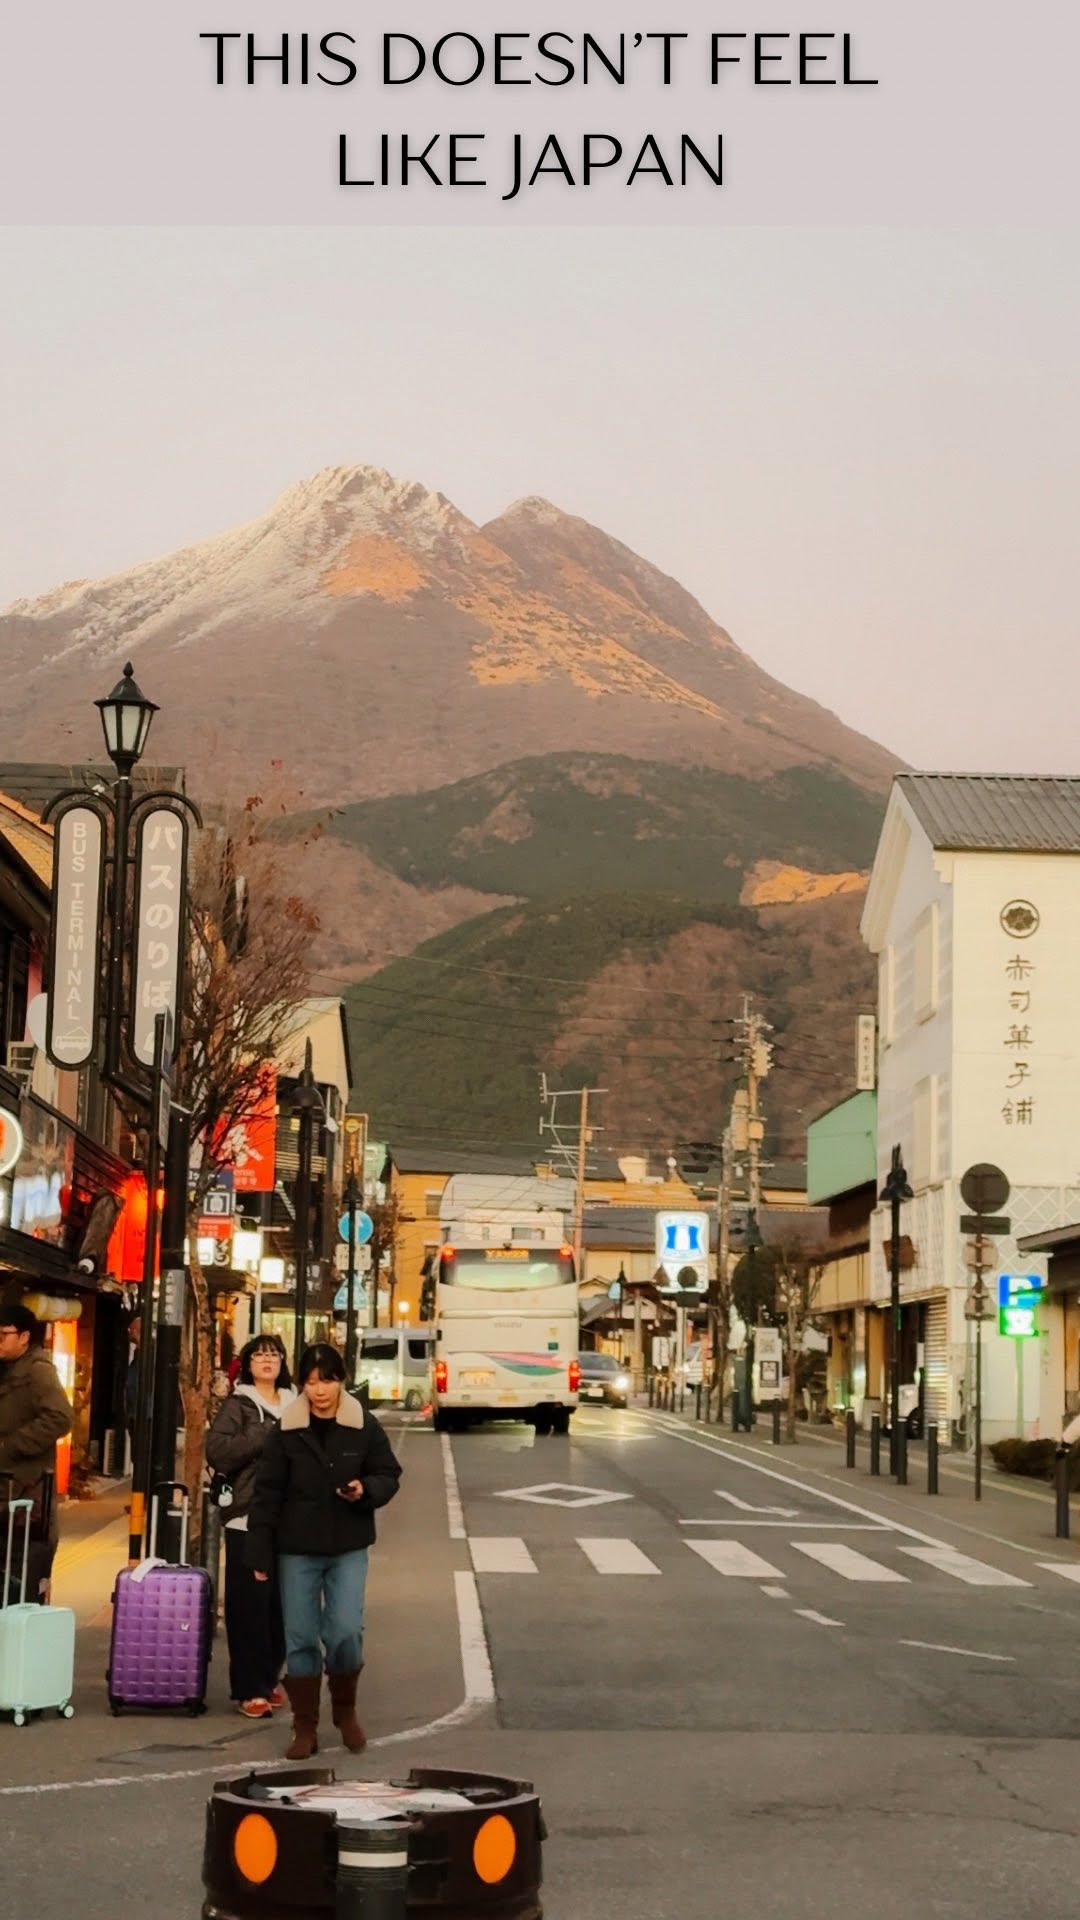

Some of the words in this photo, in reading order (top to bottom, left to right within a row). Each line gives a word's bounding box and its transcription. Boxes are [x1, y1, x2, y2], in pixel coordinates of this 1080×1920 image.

[71, 822, 87, 873] BUS
[66, 882, 85, 1021] TERMINAL
[1001, 954, 1036, 1126] 赤司菓子舗
